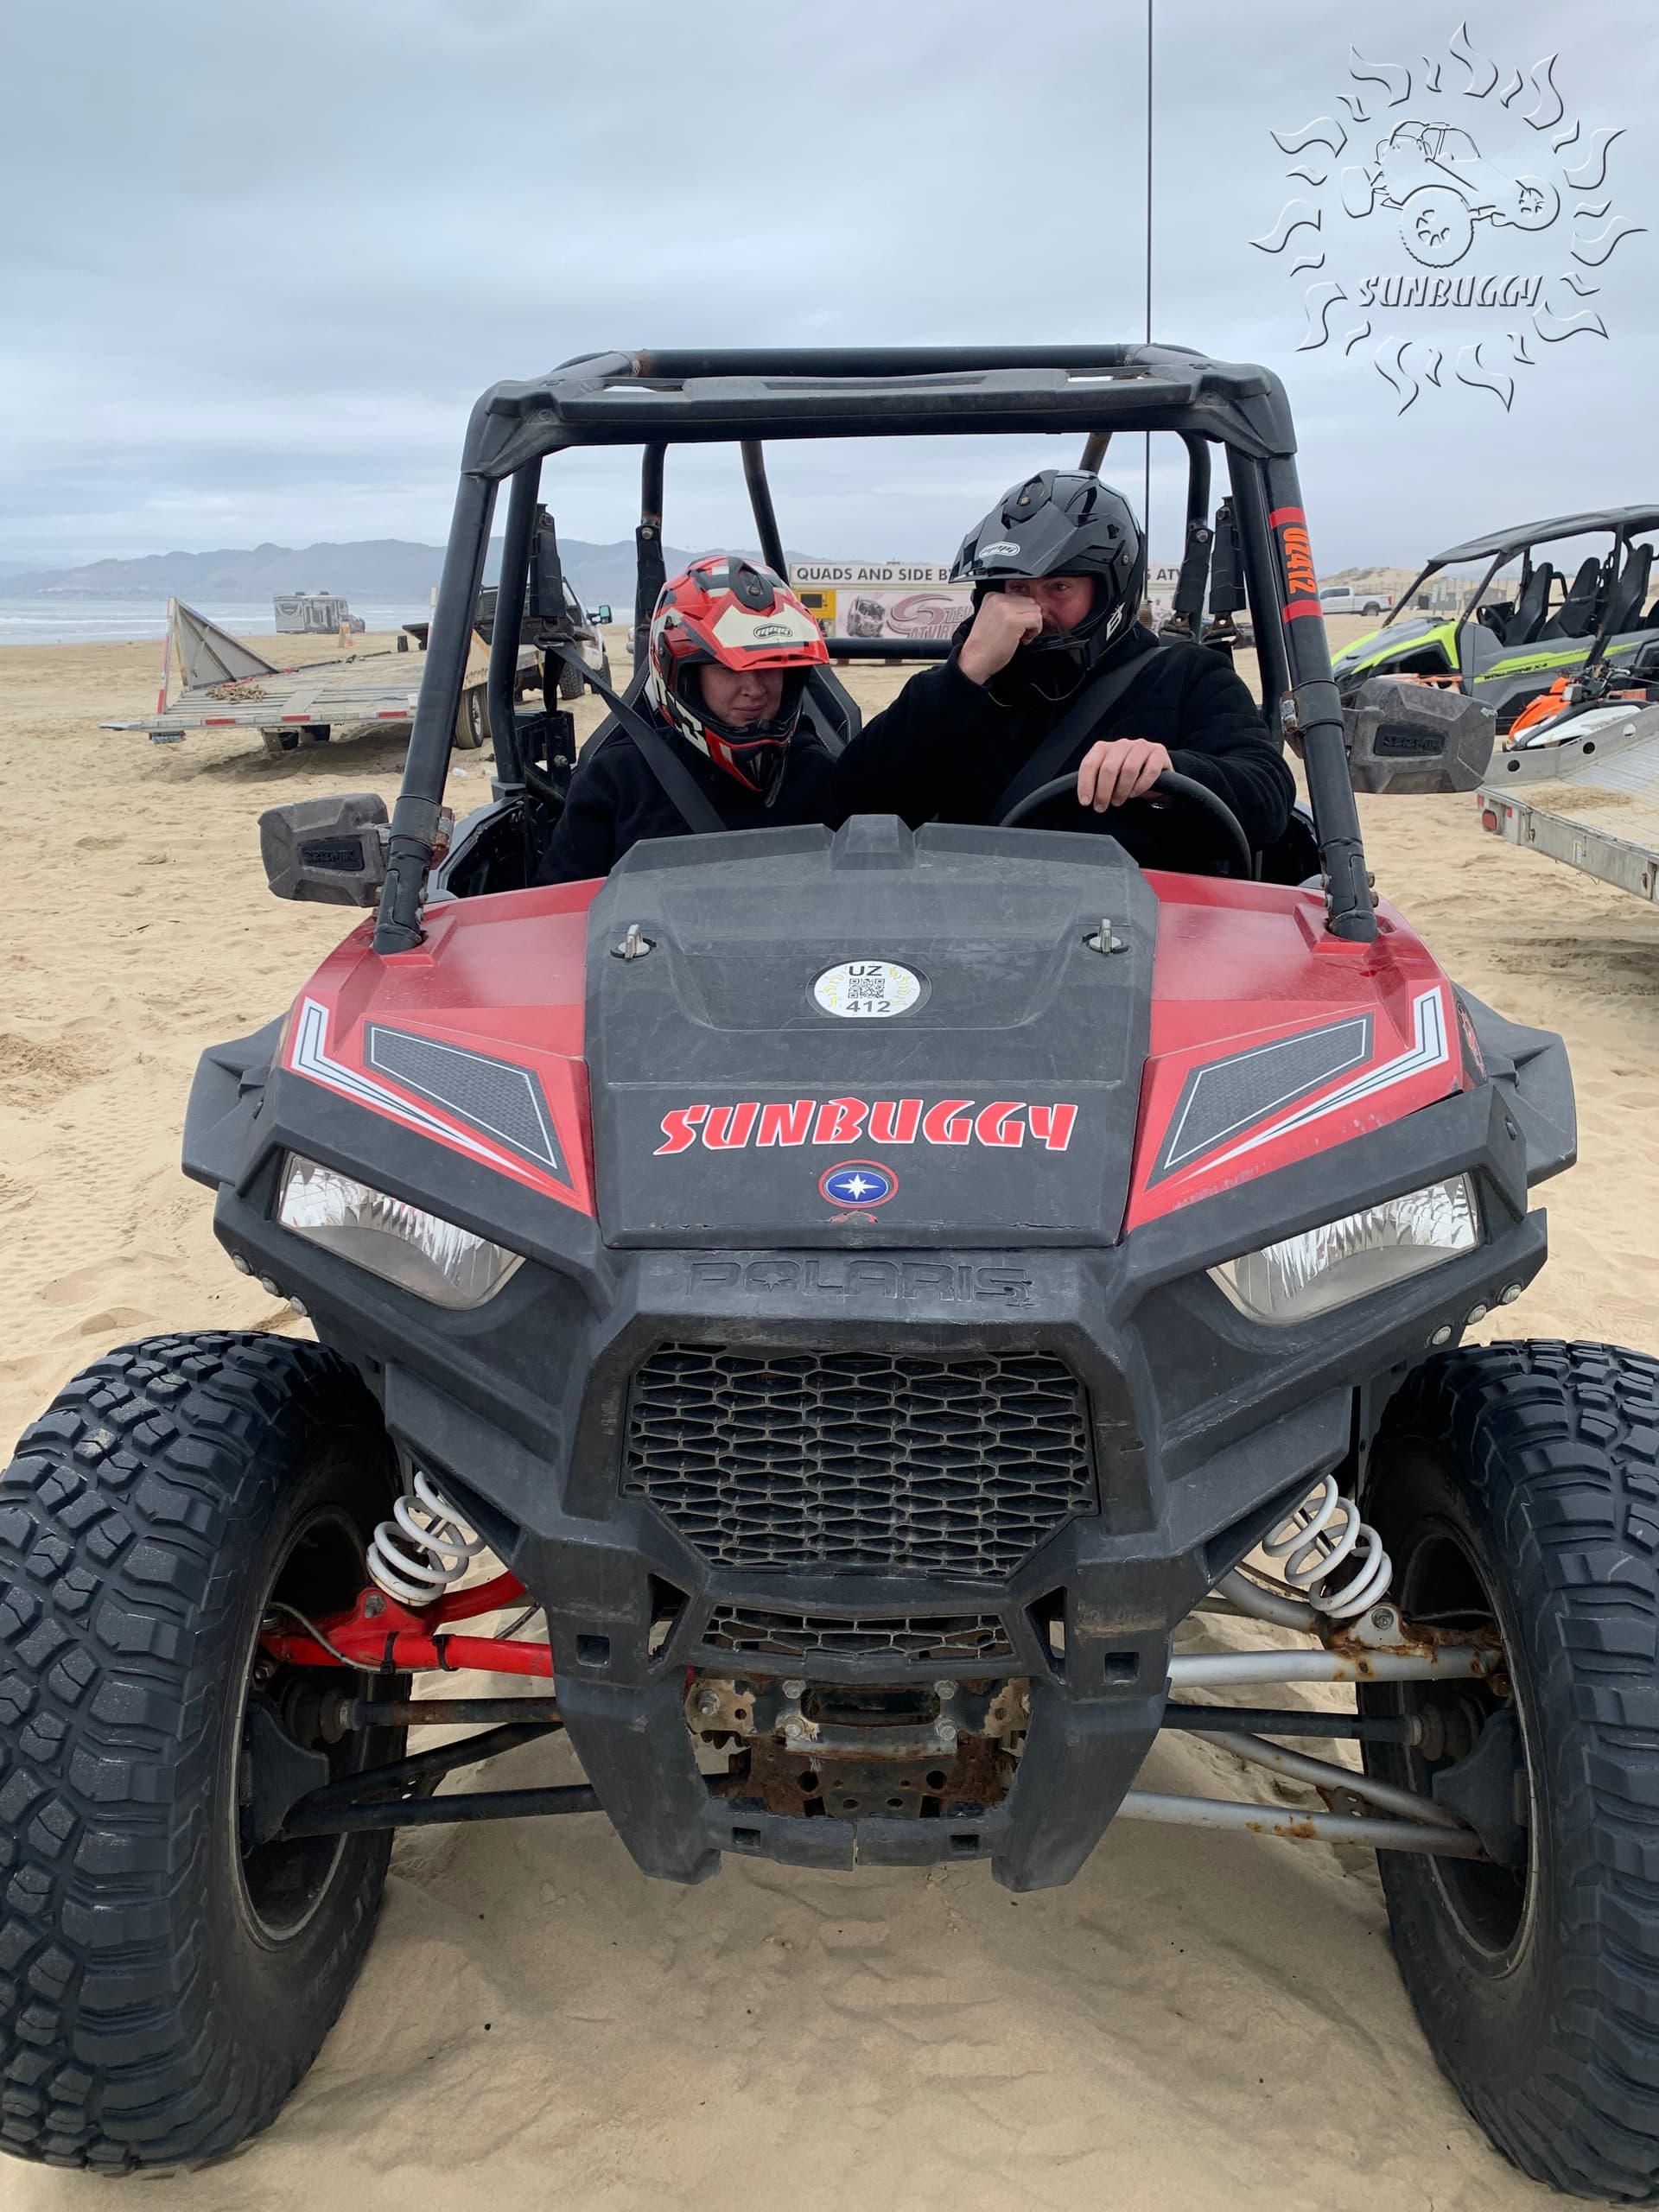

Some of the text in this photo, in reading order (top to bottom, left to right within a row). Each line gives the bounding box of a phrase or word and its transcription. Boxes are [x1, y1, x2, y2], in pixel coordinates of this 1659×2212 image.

[796, 567, 853, 581] QUADS
[857, 568, 893, 581] AND
[898, 568, 932, 581] SIDE
[938, 568, 952, 581] B
[848, 965, 883, 977] UZ
[845, 1000, 892, 1014] 412
[652, 1096, 1078, 1155] SUNBUGGY
[686, 1259, 1030, 1302] POLARIS
